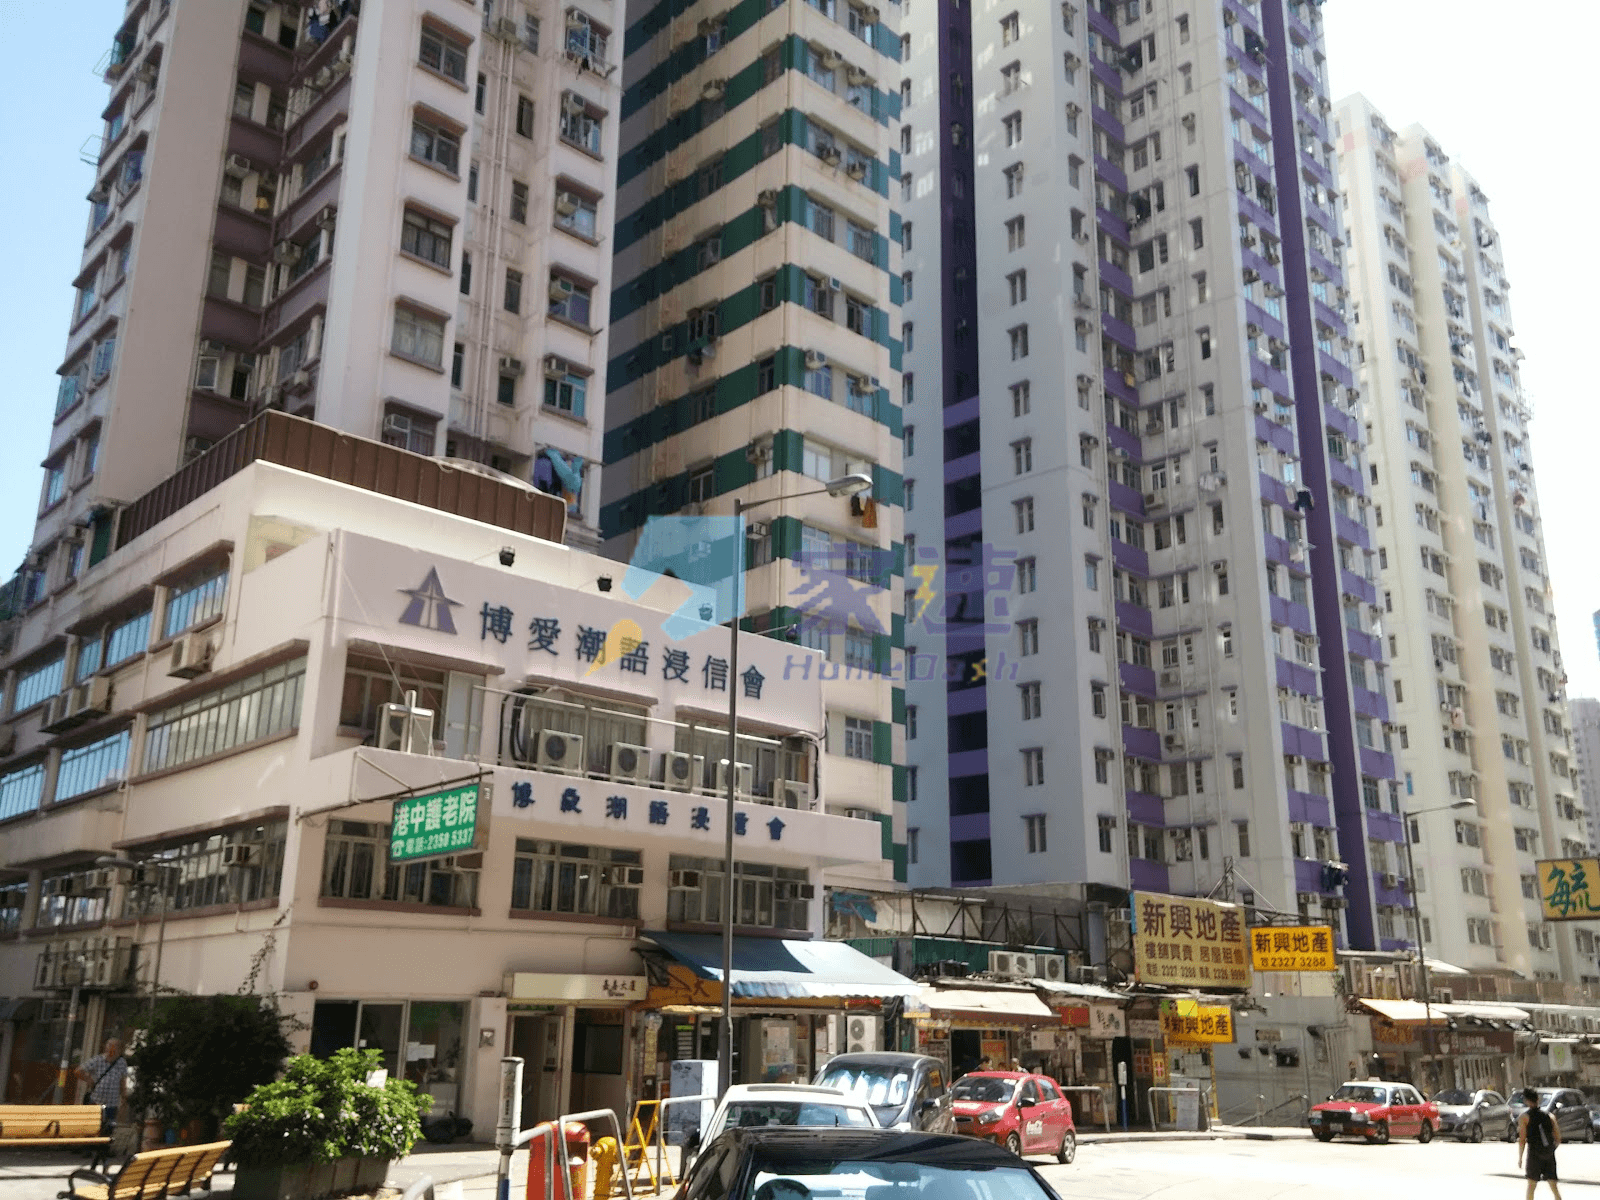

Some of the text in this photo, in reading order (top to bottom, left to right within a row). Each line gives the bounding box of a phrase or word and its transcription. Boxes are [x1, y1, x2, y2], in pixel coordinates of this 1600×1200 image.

[479, 601, 766, 700] 博愛潮語浸信會
[392, 790, 477, 836] 港中護老院
[1142, 901, 1241, 943] 新興地產
[1255, 931, 1329, 954] 新興地產
[1271, 957, 1327, 968] 2327 3288
